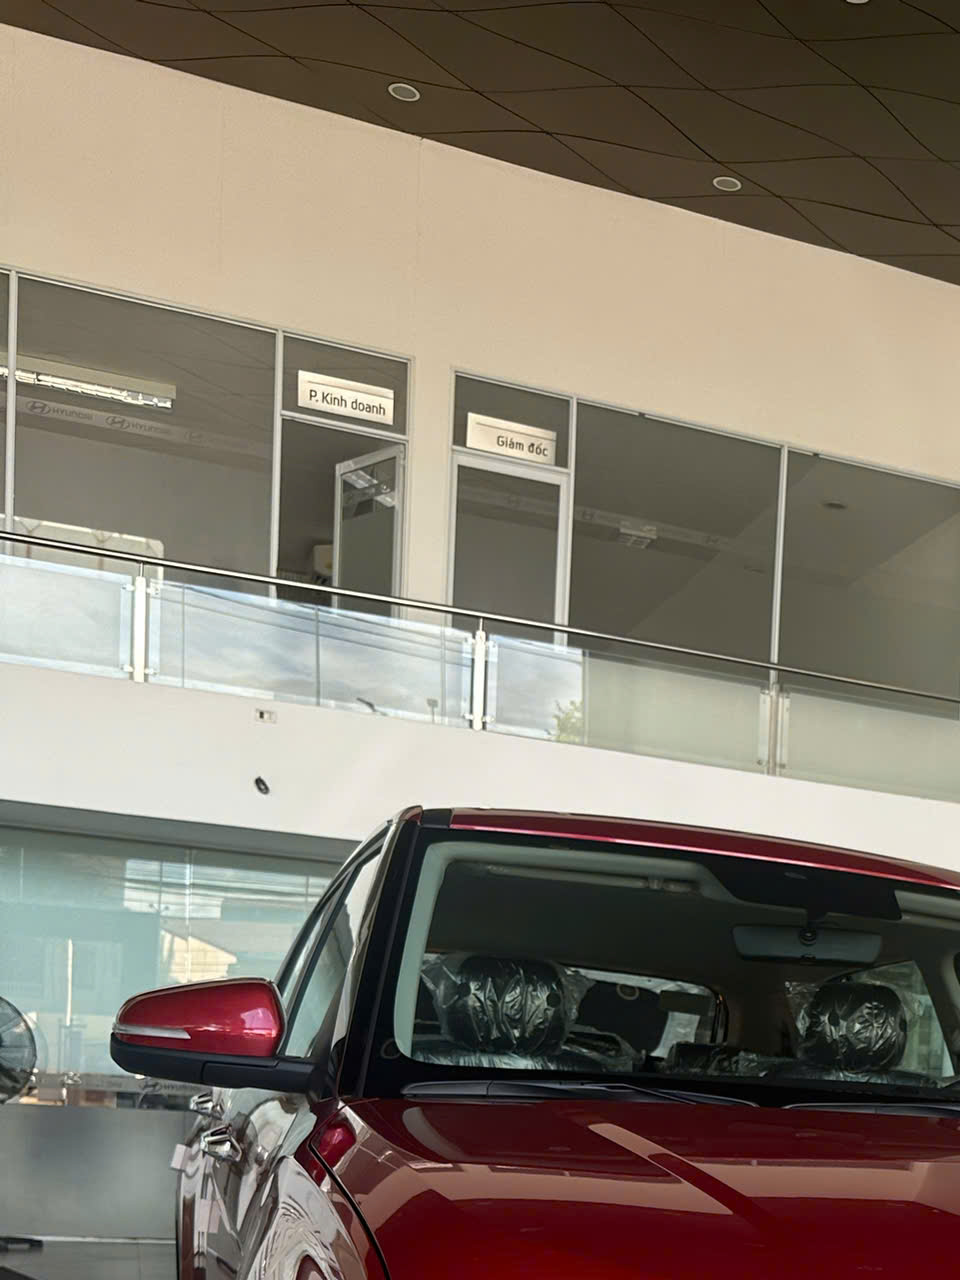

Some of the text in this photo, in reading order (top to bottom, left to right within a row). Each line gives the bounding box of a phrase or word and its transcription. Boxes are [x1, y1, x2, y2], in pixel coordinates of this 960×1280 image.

[309, 389, 386, 416] P. Kinh doanh
[496, 435, 549, 457] Giám đốc
